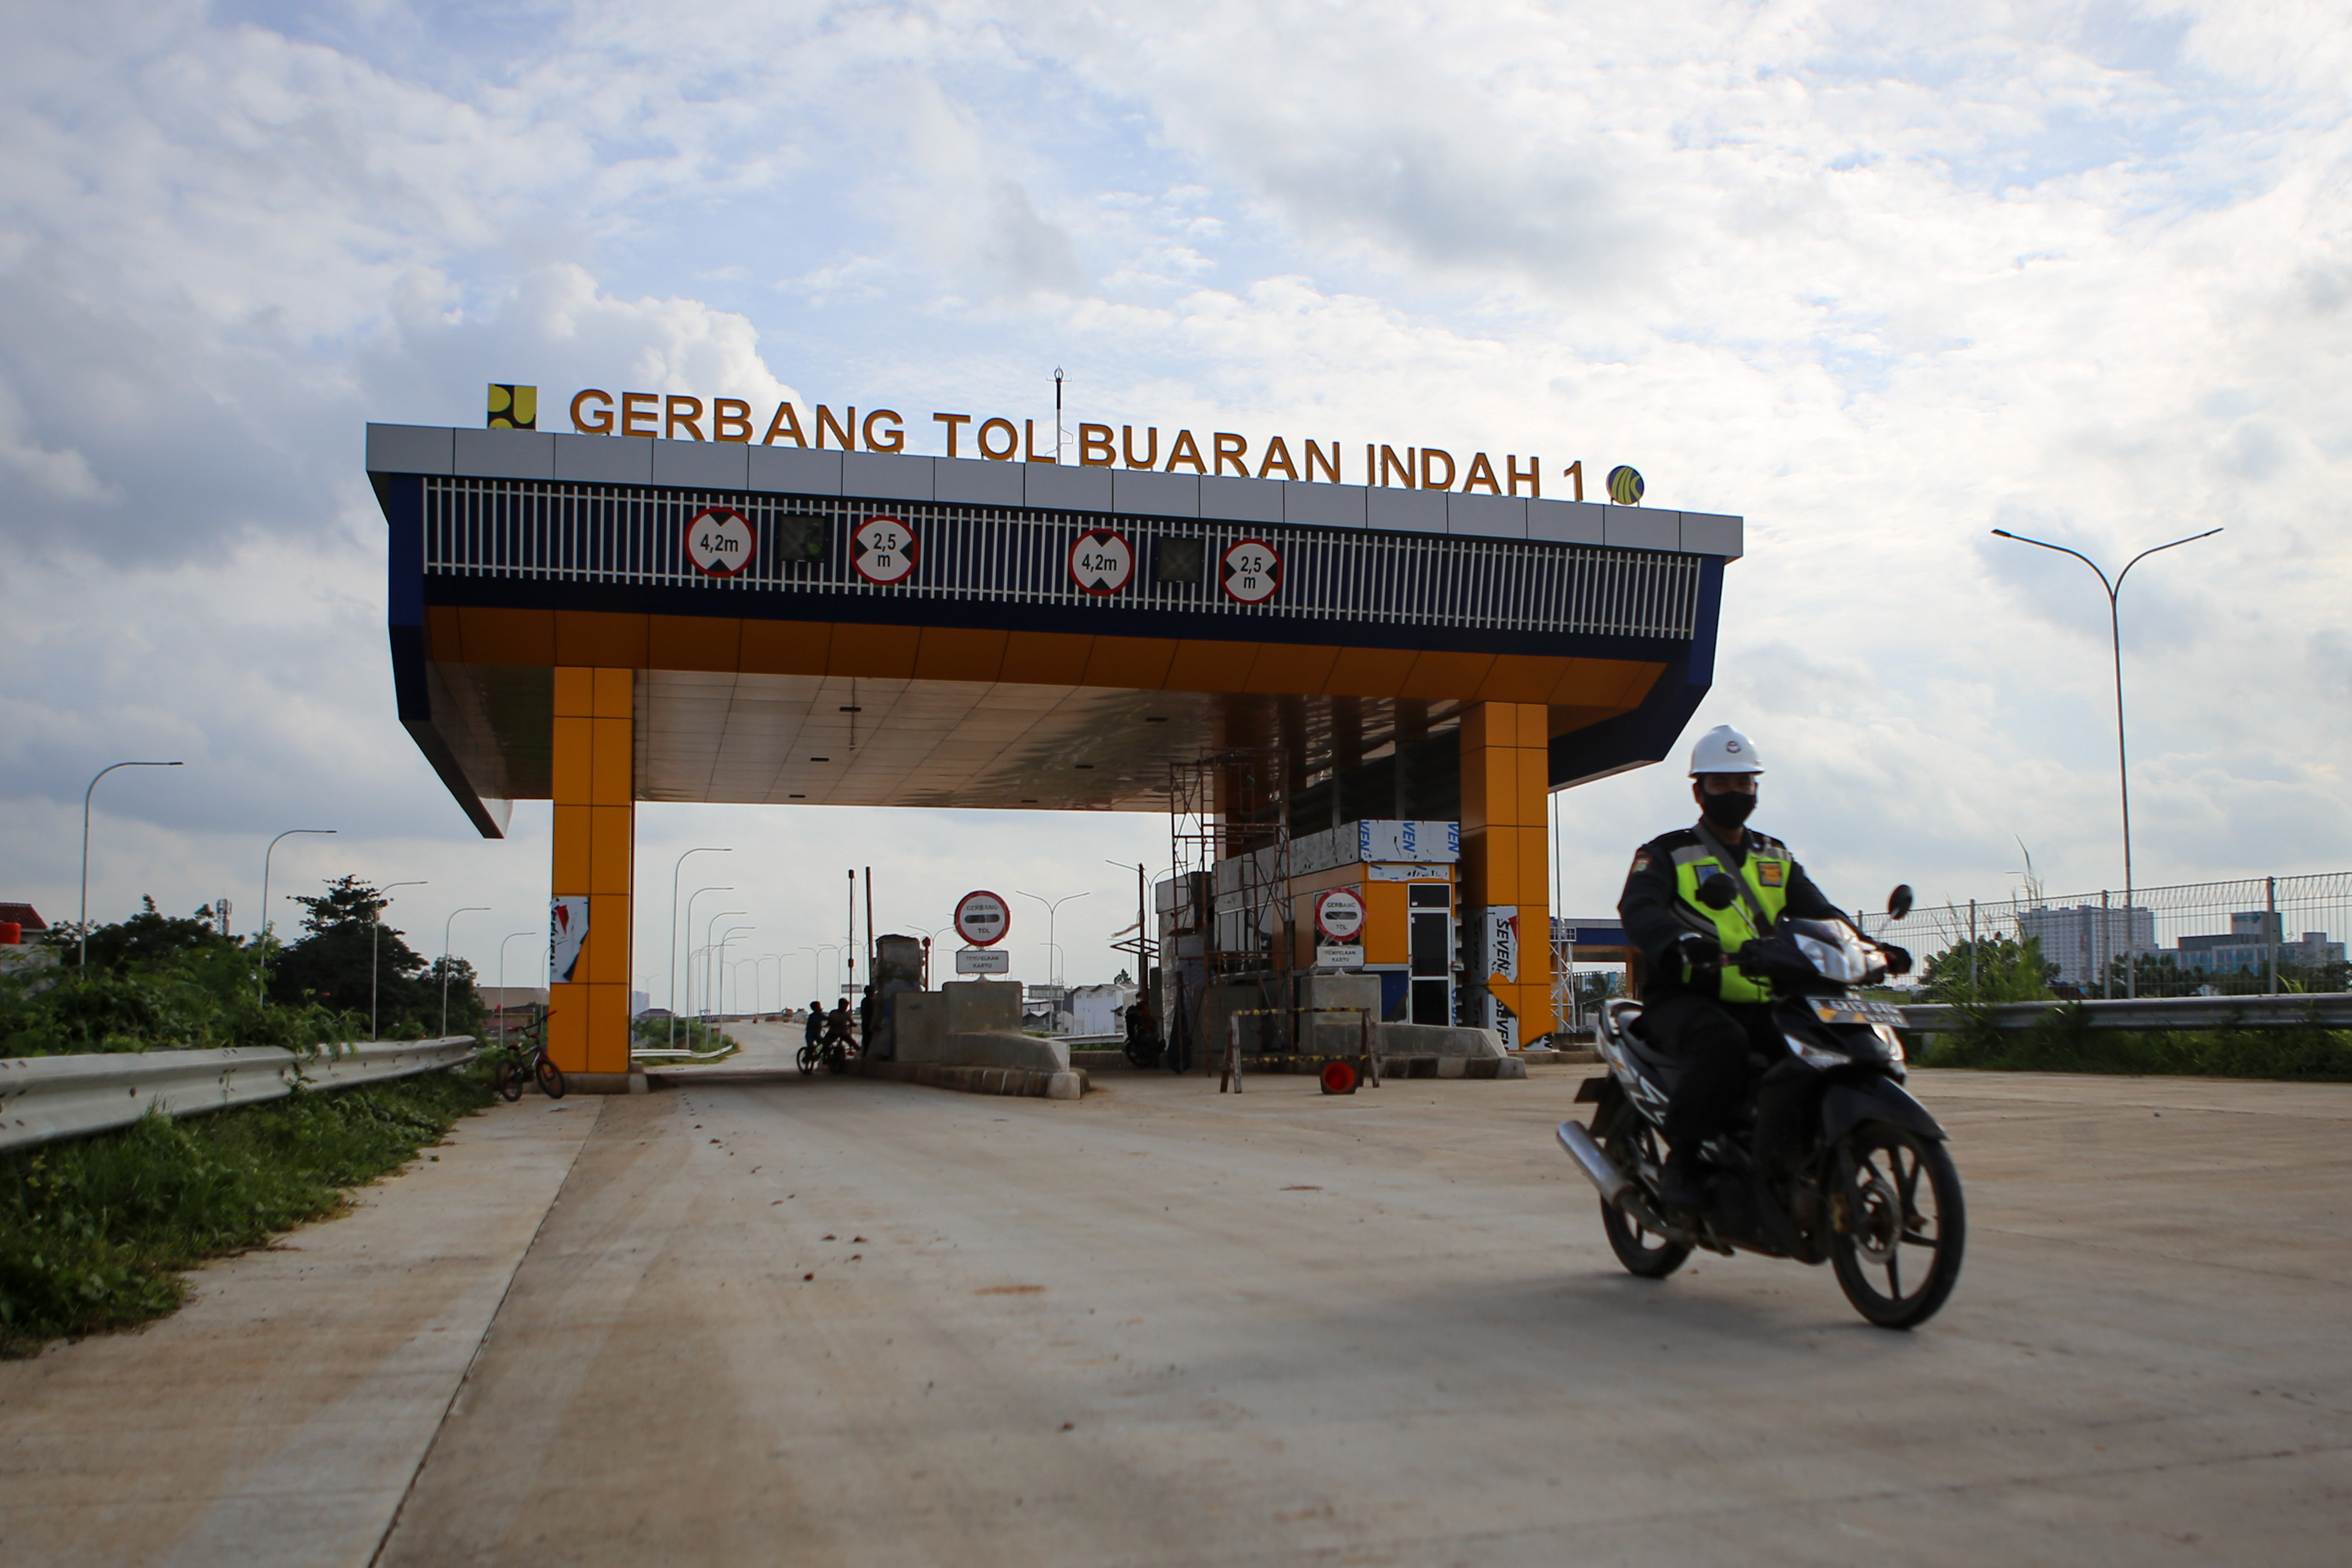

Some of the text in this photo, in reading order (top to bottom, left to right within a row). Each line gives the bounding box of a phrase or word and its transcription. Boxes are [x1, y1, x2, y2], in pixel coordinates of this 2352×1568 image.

[569, 389, 1584, 502] GERBANG TOL BUARAN INDAH 1
[700, 533, 739, 553] 4,2m
[873, 533, 896, 552] 2,5
[878, 554, 890, 567] m
[1082, 553, 1117, 573] 4,2m
[1241, 556, 1262, 574] 2,5
[1244, 577, 1256, 589] m
[1403, 822, 1415, 852] VEN
[1448, 824, 1459, 852] VEN
[1496, 918, 1511, 971] SEVEN
